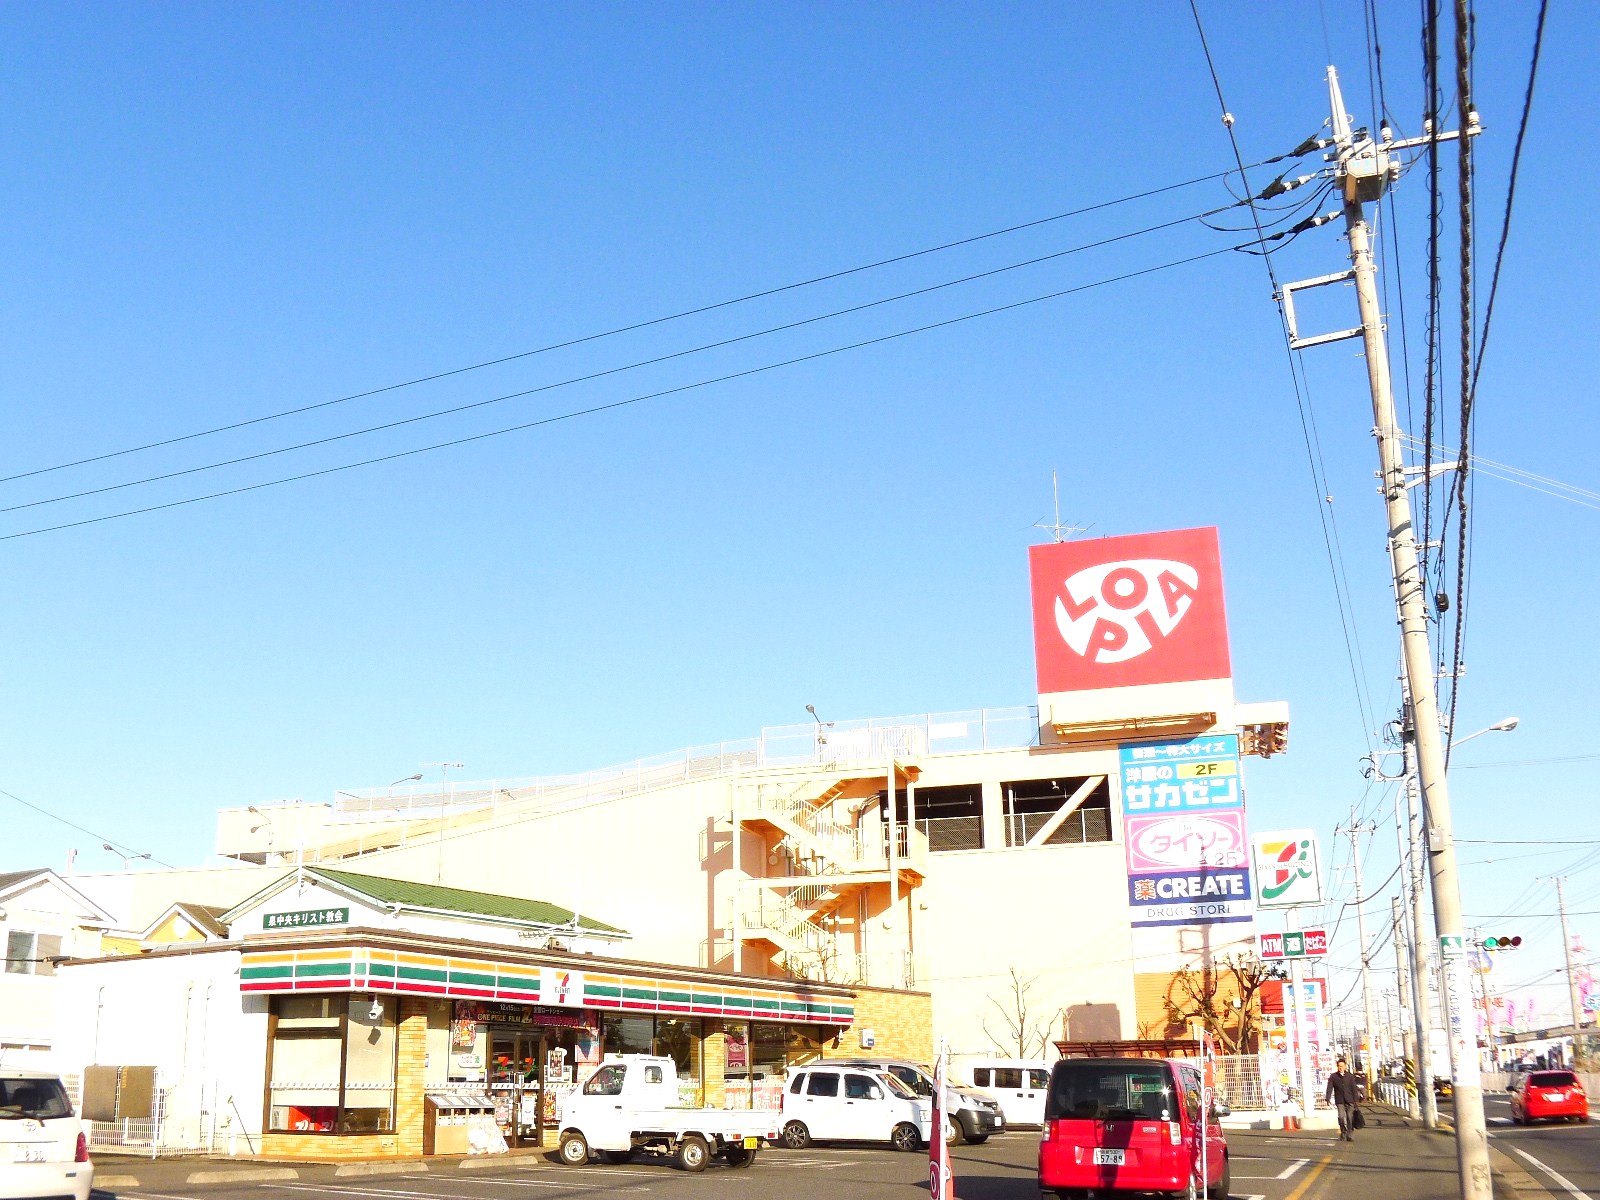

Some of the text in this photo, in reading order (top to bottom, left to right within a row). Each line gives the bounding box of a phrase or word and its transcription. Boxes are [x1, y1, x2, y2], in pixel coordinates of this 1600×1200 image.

[1195, 763, 1218, 776] 2F
[1126, 778, 1238, 810] サカゼン
[1134, 874, 1244, 900] 薬 CREATE
[268, 909, 344, 927] 泉中央キリスト教会
[1147, 907, 1184, 918] DRUG
[1262, 938, 1282, 954] ATM
[1305, 935, 1327, 950] たばこ
